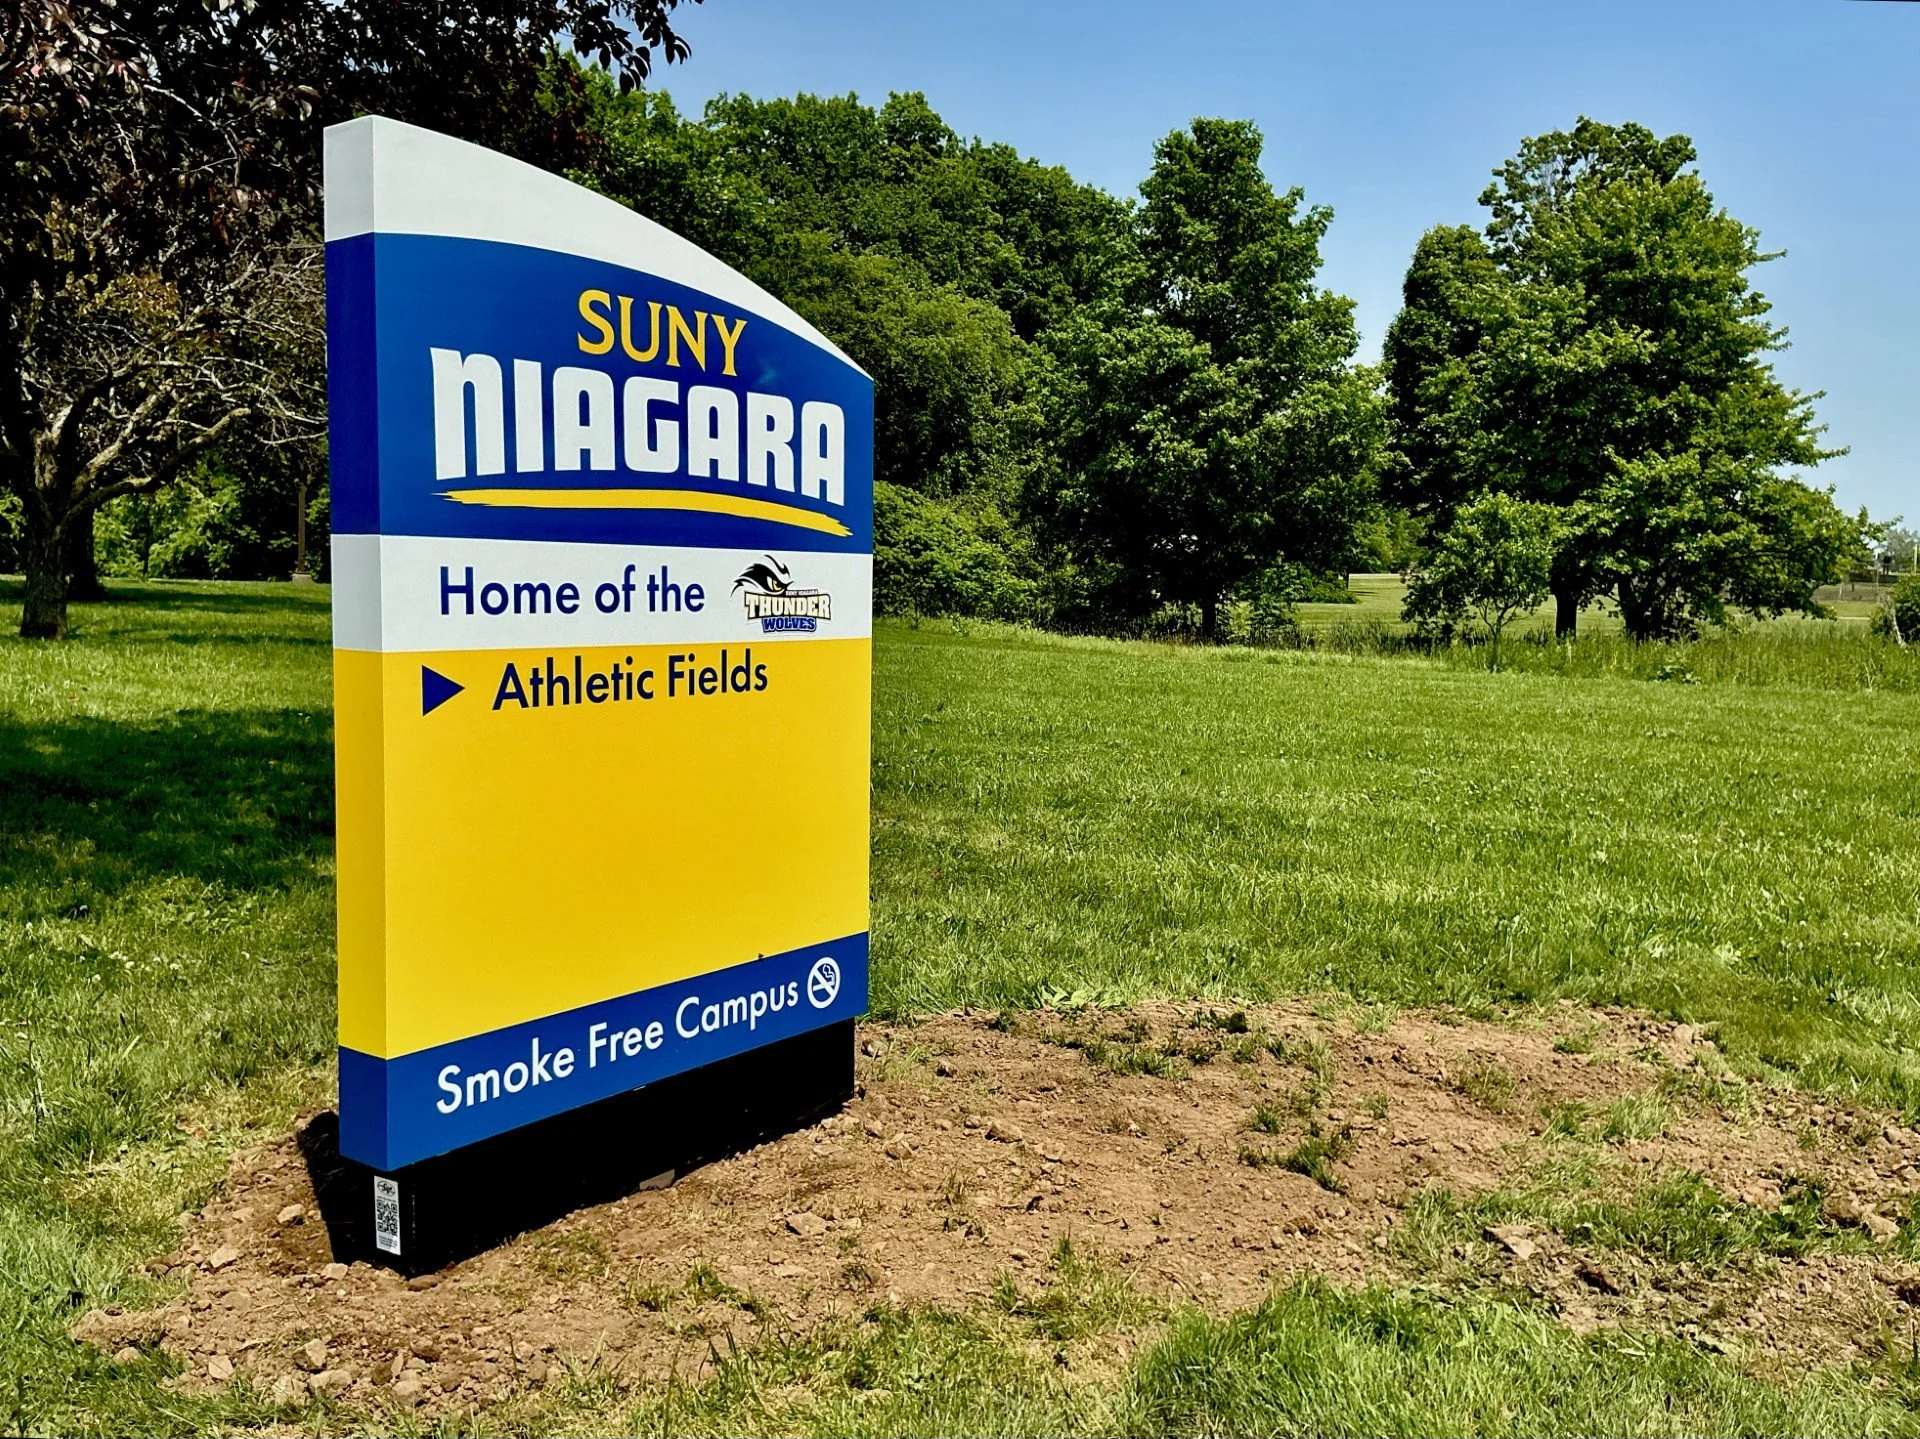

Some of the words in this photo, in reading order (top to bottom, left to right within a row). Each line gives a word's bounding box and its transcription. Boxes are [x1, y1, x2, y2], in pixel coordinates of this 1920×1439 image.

[577, 289, 748, 376] SUNY
[430, 347, 846, 507] NIAGARA
[439, 566, 580, 616] Home
[594, 565, 637, 614] of
[646, 565, 706, 612] the
[745, 595, 831, 619] THUNDER
[763, 617, 816, 632] WOLVES
[492, 656, 655, 711] Athletic
[668, 649, 769, 697] Fields
[436, 1037, 576, 1115] Smoke
[589, 1022, 664, 1069] Free
[675, 980, 799, 1039] Campus
